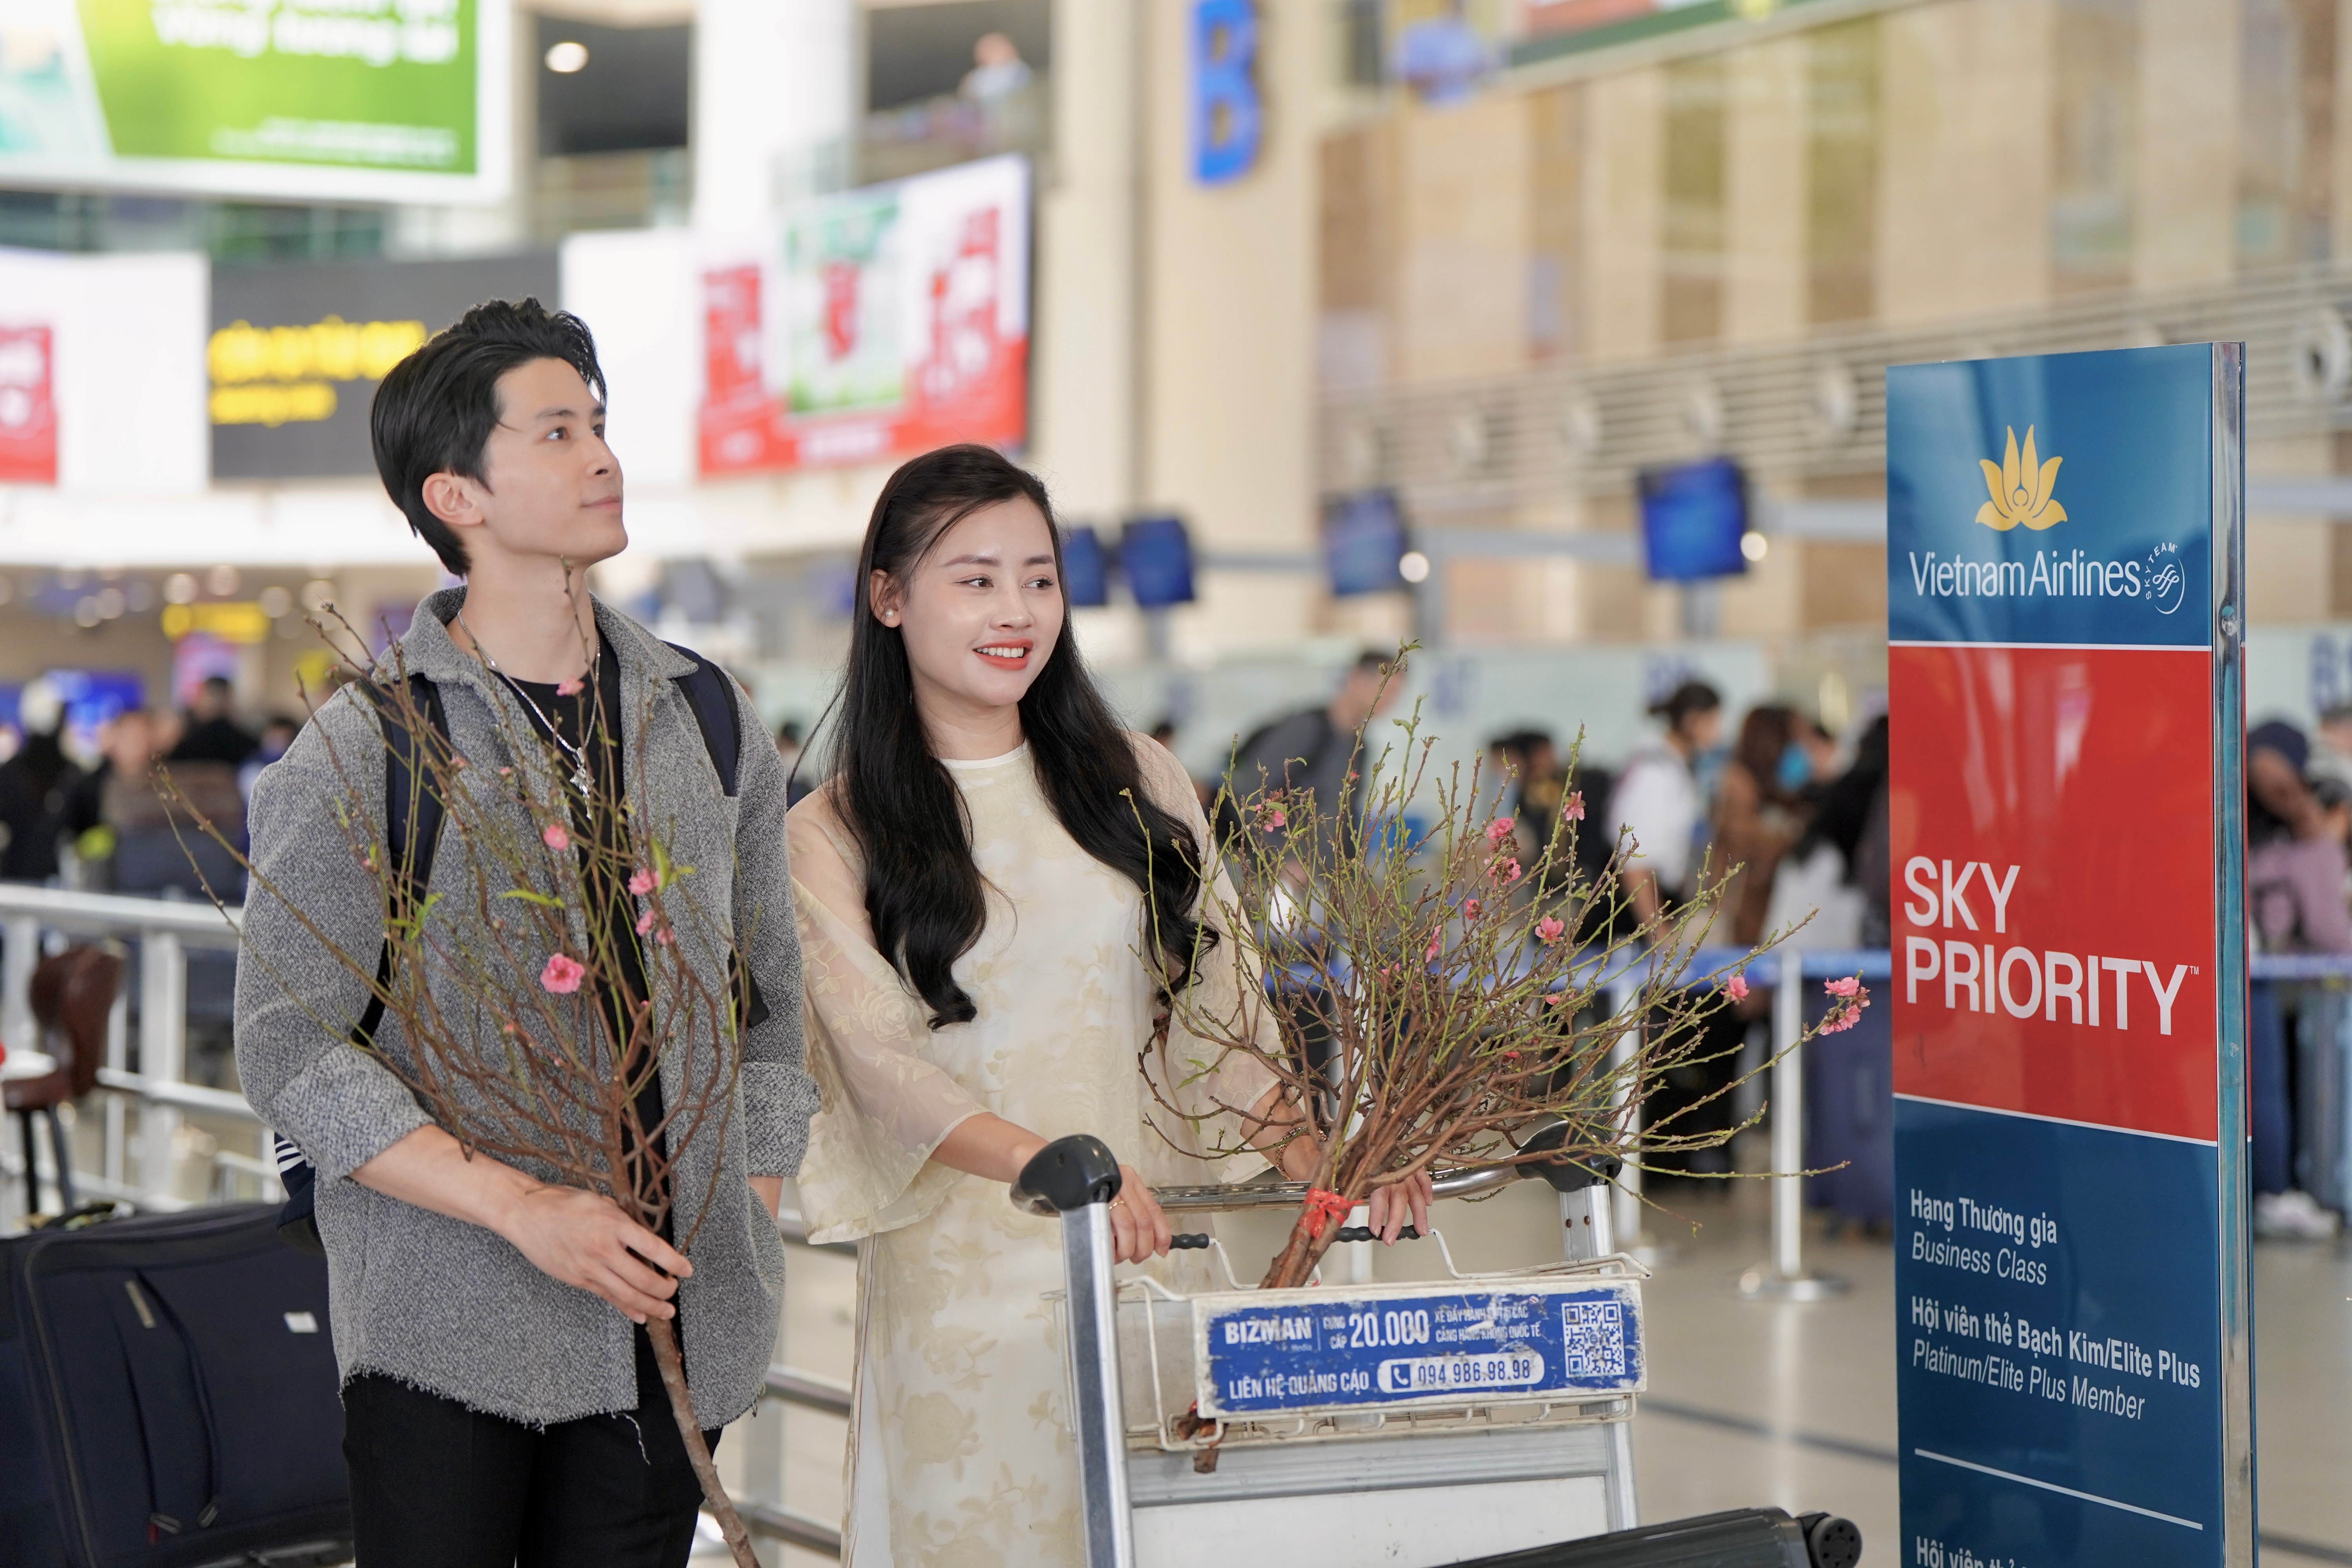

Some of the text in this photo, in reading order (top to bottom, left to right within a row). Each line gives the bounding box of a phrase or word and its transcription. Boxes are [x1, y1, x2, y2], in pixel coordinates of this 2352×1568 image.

[1909, 549, 2141, 597] Vietnam Airlines
[2144, 542, 2177, 600] SKYTEAM
[1904, 856, 2021, 933] SKY
[1906, 935, 2188, 1036] PRIORITY
[1911, 1188, 2057, 1248] Hạng Thương gia
[1912, 1231, 2047, 1285] Business Class
[1224, 1316, 1312, 1345] BIZMAN
[1348, 1309, 1430, 1348] 20.000
[1530, 1320, 1542, 1337] TẾ
[1912, 1296, 2200, 1388] Hội viên thẻ Bạch Kim/Elite Plus
[1229, 1375, 1263, 1400] LIÊN
[1265, 1373, 1285, 1400] HỆ
[1288, 1369, 1338, 1396] QUẢNG
[1913, 1338, 2145, 1420] Platinum/Elite Plus Member
